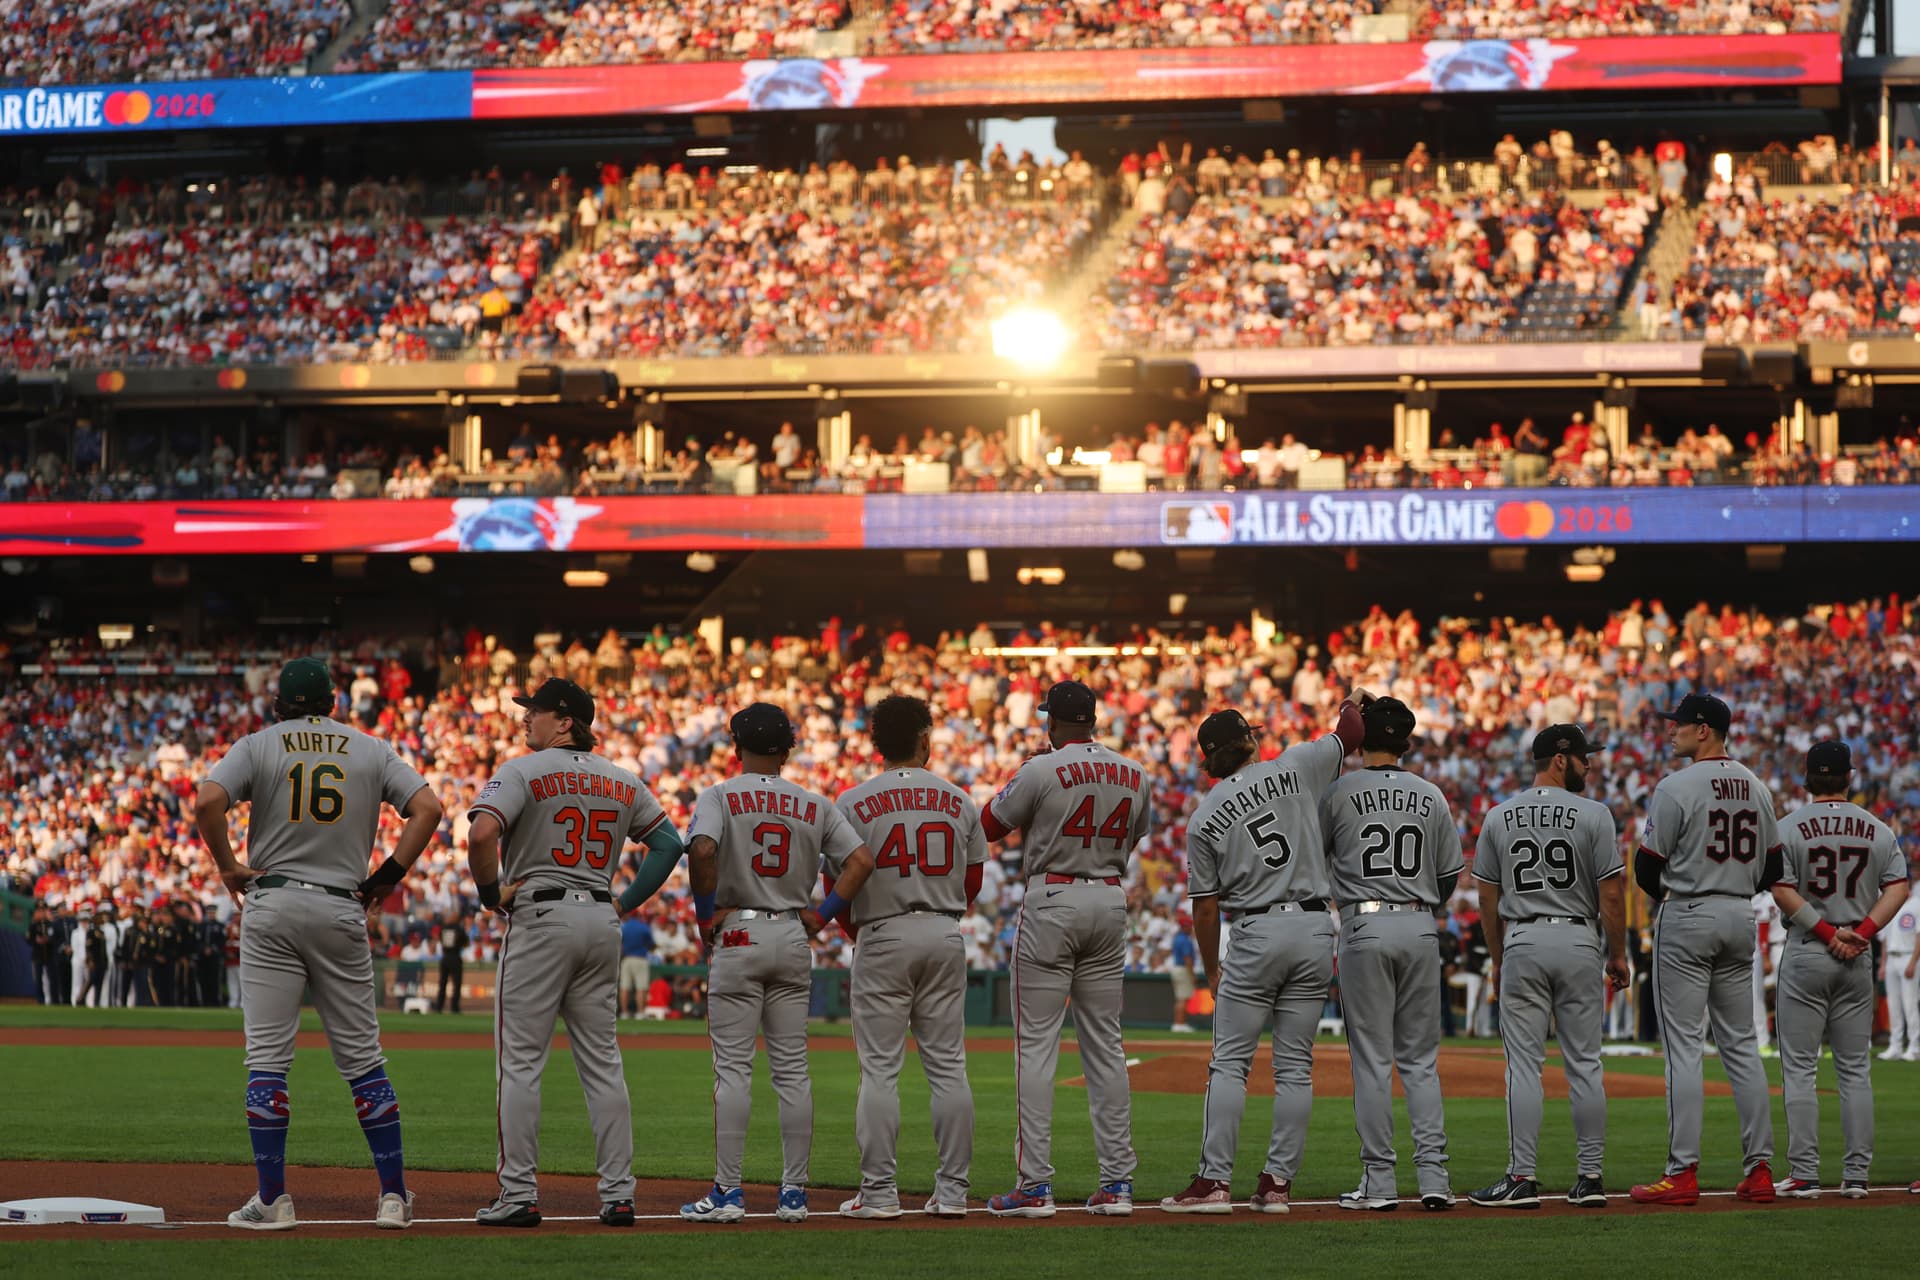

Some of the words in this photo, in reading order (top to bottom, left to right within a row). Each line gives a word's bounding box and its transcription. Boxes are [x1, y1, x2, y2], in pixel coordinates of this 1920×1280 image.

[25, 87, 104, 129] GAME
[154, 93, 215, 118] 2026
[1236, 494, 1306, 541] ALL
[1308, 493, 1395, 542] STAR
[1399, 492, 1495, 541] GAME
[1559, 506, 1632, 532] 2026
[282, 732, 350, 755] KURTZ
[287, 760, 346, 824] 16
[529, 771, 637, 807] RUTSCHMAN
[1055, 761, 1141, 793] CHAPMAN
[1711, 778, 1750, 801] SMITH
[726, 791, 817, 826] RAFAELA
[853, 787, 963, 824] CONTRERAS
[1062, 795, 1133, 849] 44
[1200, 768, 1301, 843] MURAKAMI
[1349, 789, 1434, 819] VARGAS
[1503, 805, 1578, 832] PETERS
[551, 806, 619, 869] 35
[751, 821, 791, 878] 3
[876, 821, 954, 877] 40
[1244, 810, 1293, 871] 5
[1360, 822, 1424, 880] 20
[1706, 808, 1758, 865] 36
[1797, 816, 1876, 842] BAZZANA
[1509, 837, 1577, 894] 29
[1808, 845, 1870, 899] 37
